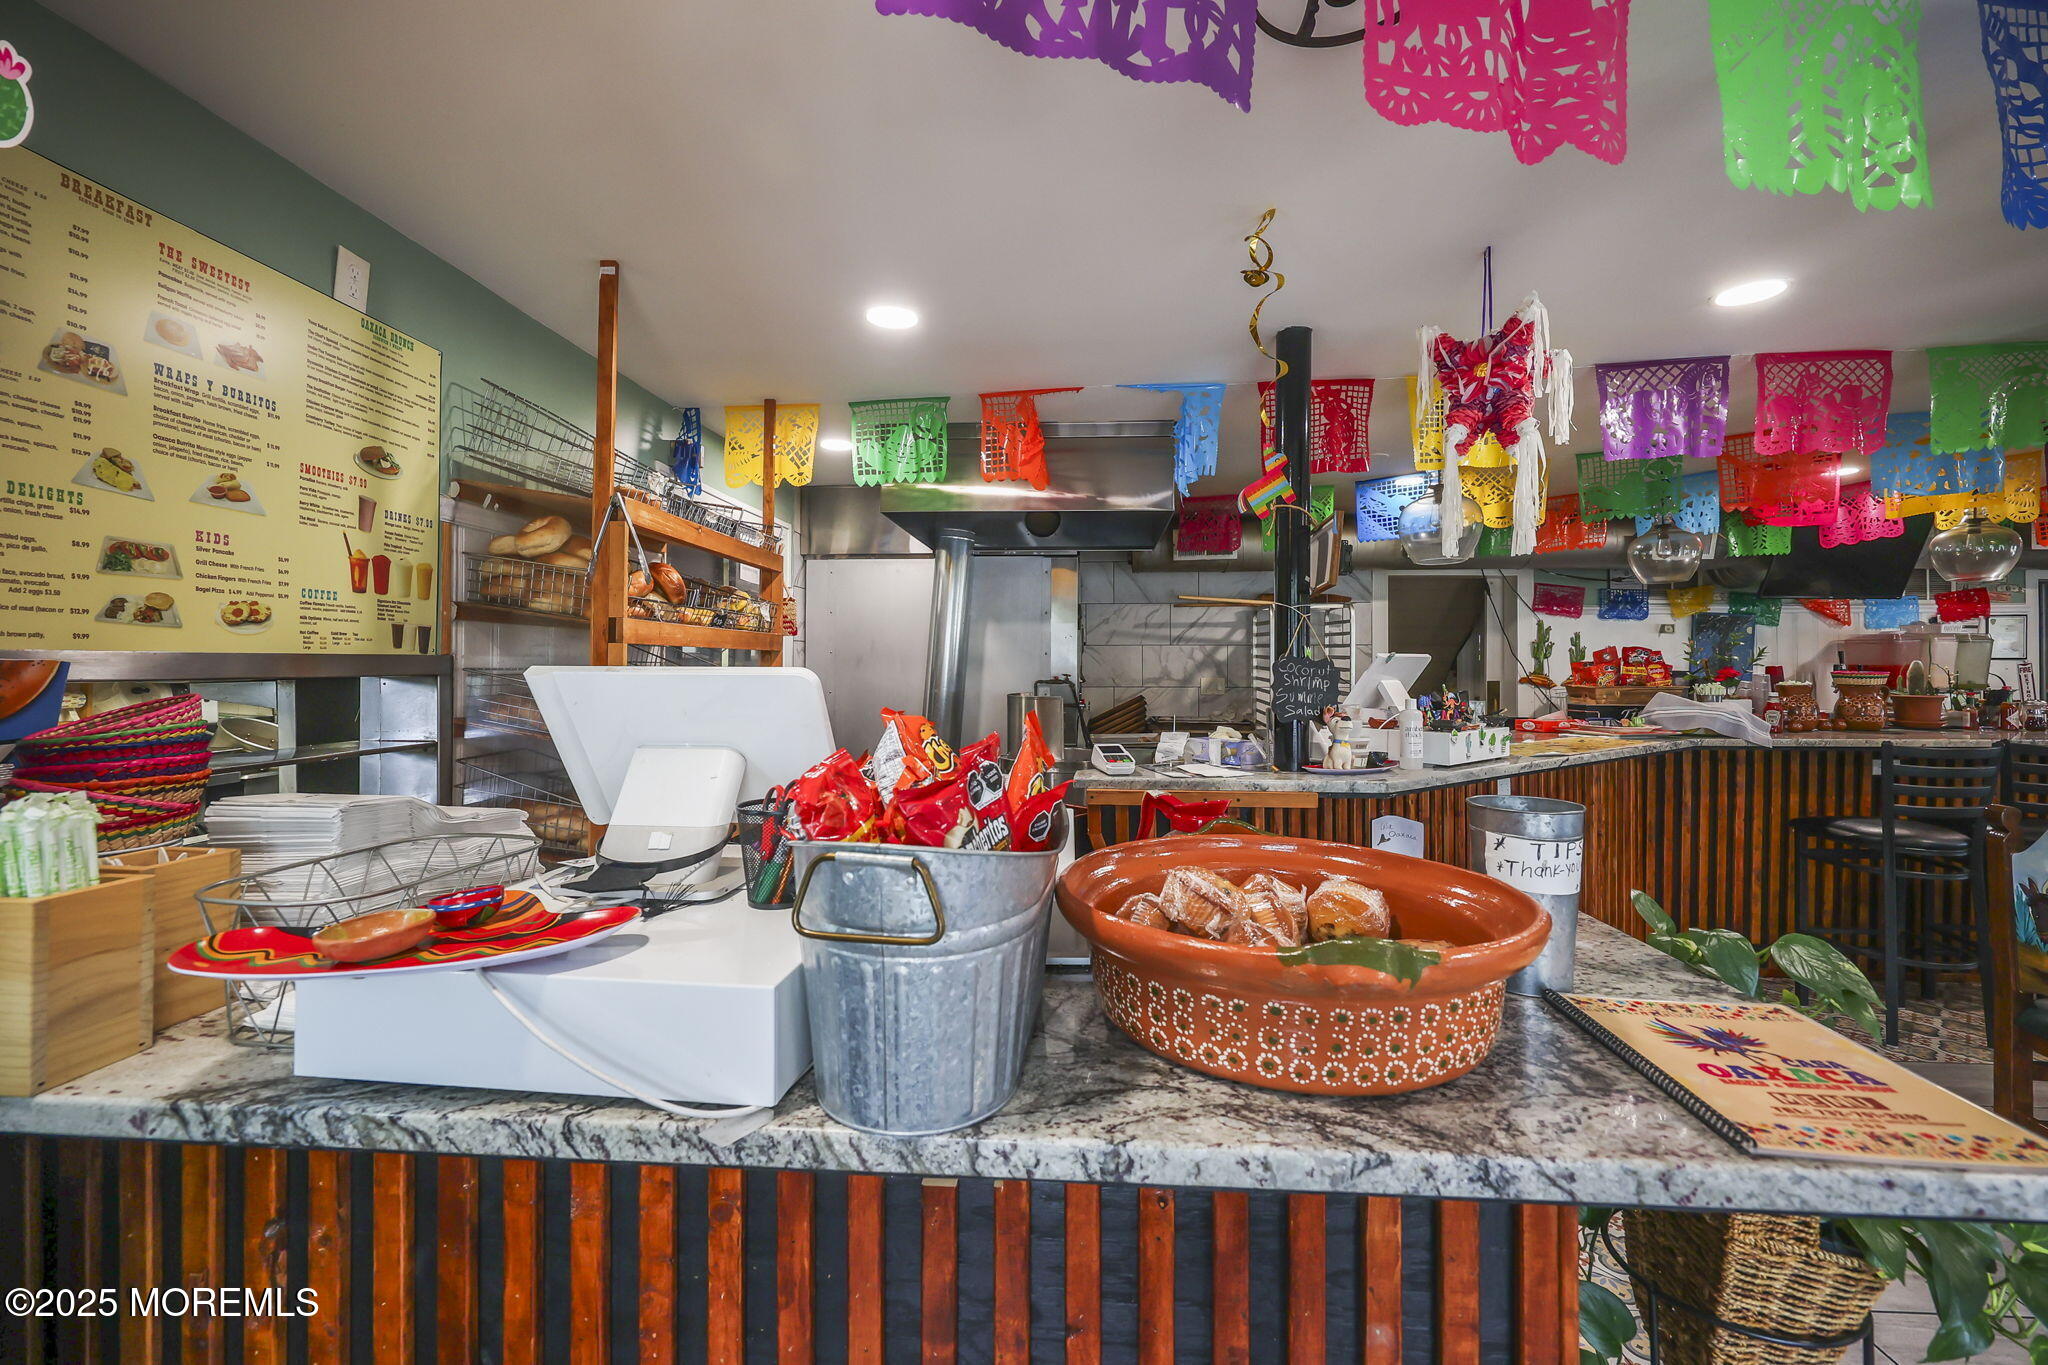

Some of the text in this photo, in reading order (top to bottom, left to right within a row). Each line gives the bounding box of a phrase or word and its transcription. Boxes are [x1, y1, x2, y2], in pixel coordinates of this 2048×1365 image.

[60, 172, 153, 228] BREAKFAST
[158, 241, 183, 263] THE
[191, 256, 251, 293] SWEETEST
[360, 318, 414, 352] OAXACA BRUNCH
[153, 362, 277, 412] WRAPS Y BURRITOS
[153, 377, 183, 391] Breakfast
[184, 385, 200, 397] Wrap
[153, 405, 181, 418] Breakfast
[182, 413, 201, 423] Burrito
[152, 433, 176, 444] Oaxaca
[176, 438, 196, 449] Burrito
[299, 462, 344, 483] SMOOTHIES
[7, 480, 84, 506] DELIGHTS
[68, 507, 90, 516] $14.99
[384, 509, 412, 525] DRINKS
[195, 530, 230, 546] KIDS
[212, 548, 235, 556] Pancake
[195, 572, 217, 580] Chicken
[217, 574, 237, 583] Fingers
[7, 586, 22, 594] Add
[195, 586, 211, 594] Bagel
[301, 588, 338, 601] COFFEE
[69, 608, 90, 616] $12.99
[72, 632, 90, 640] $9.99
[1283, 673, 1330, 692] Shrimp
[1780, 1058, 1851, 1070] CASA
[1696, 1063, 1889, 1087] OAXACA
